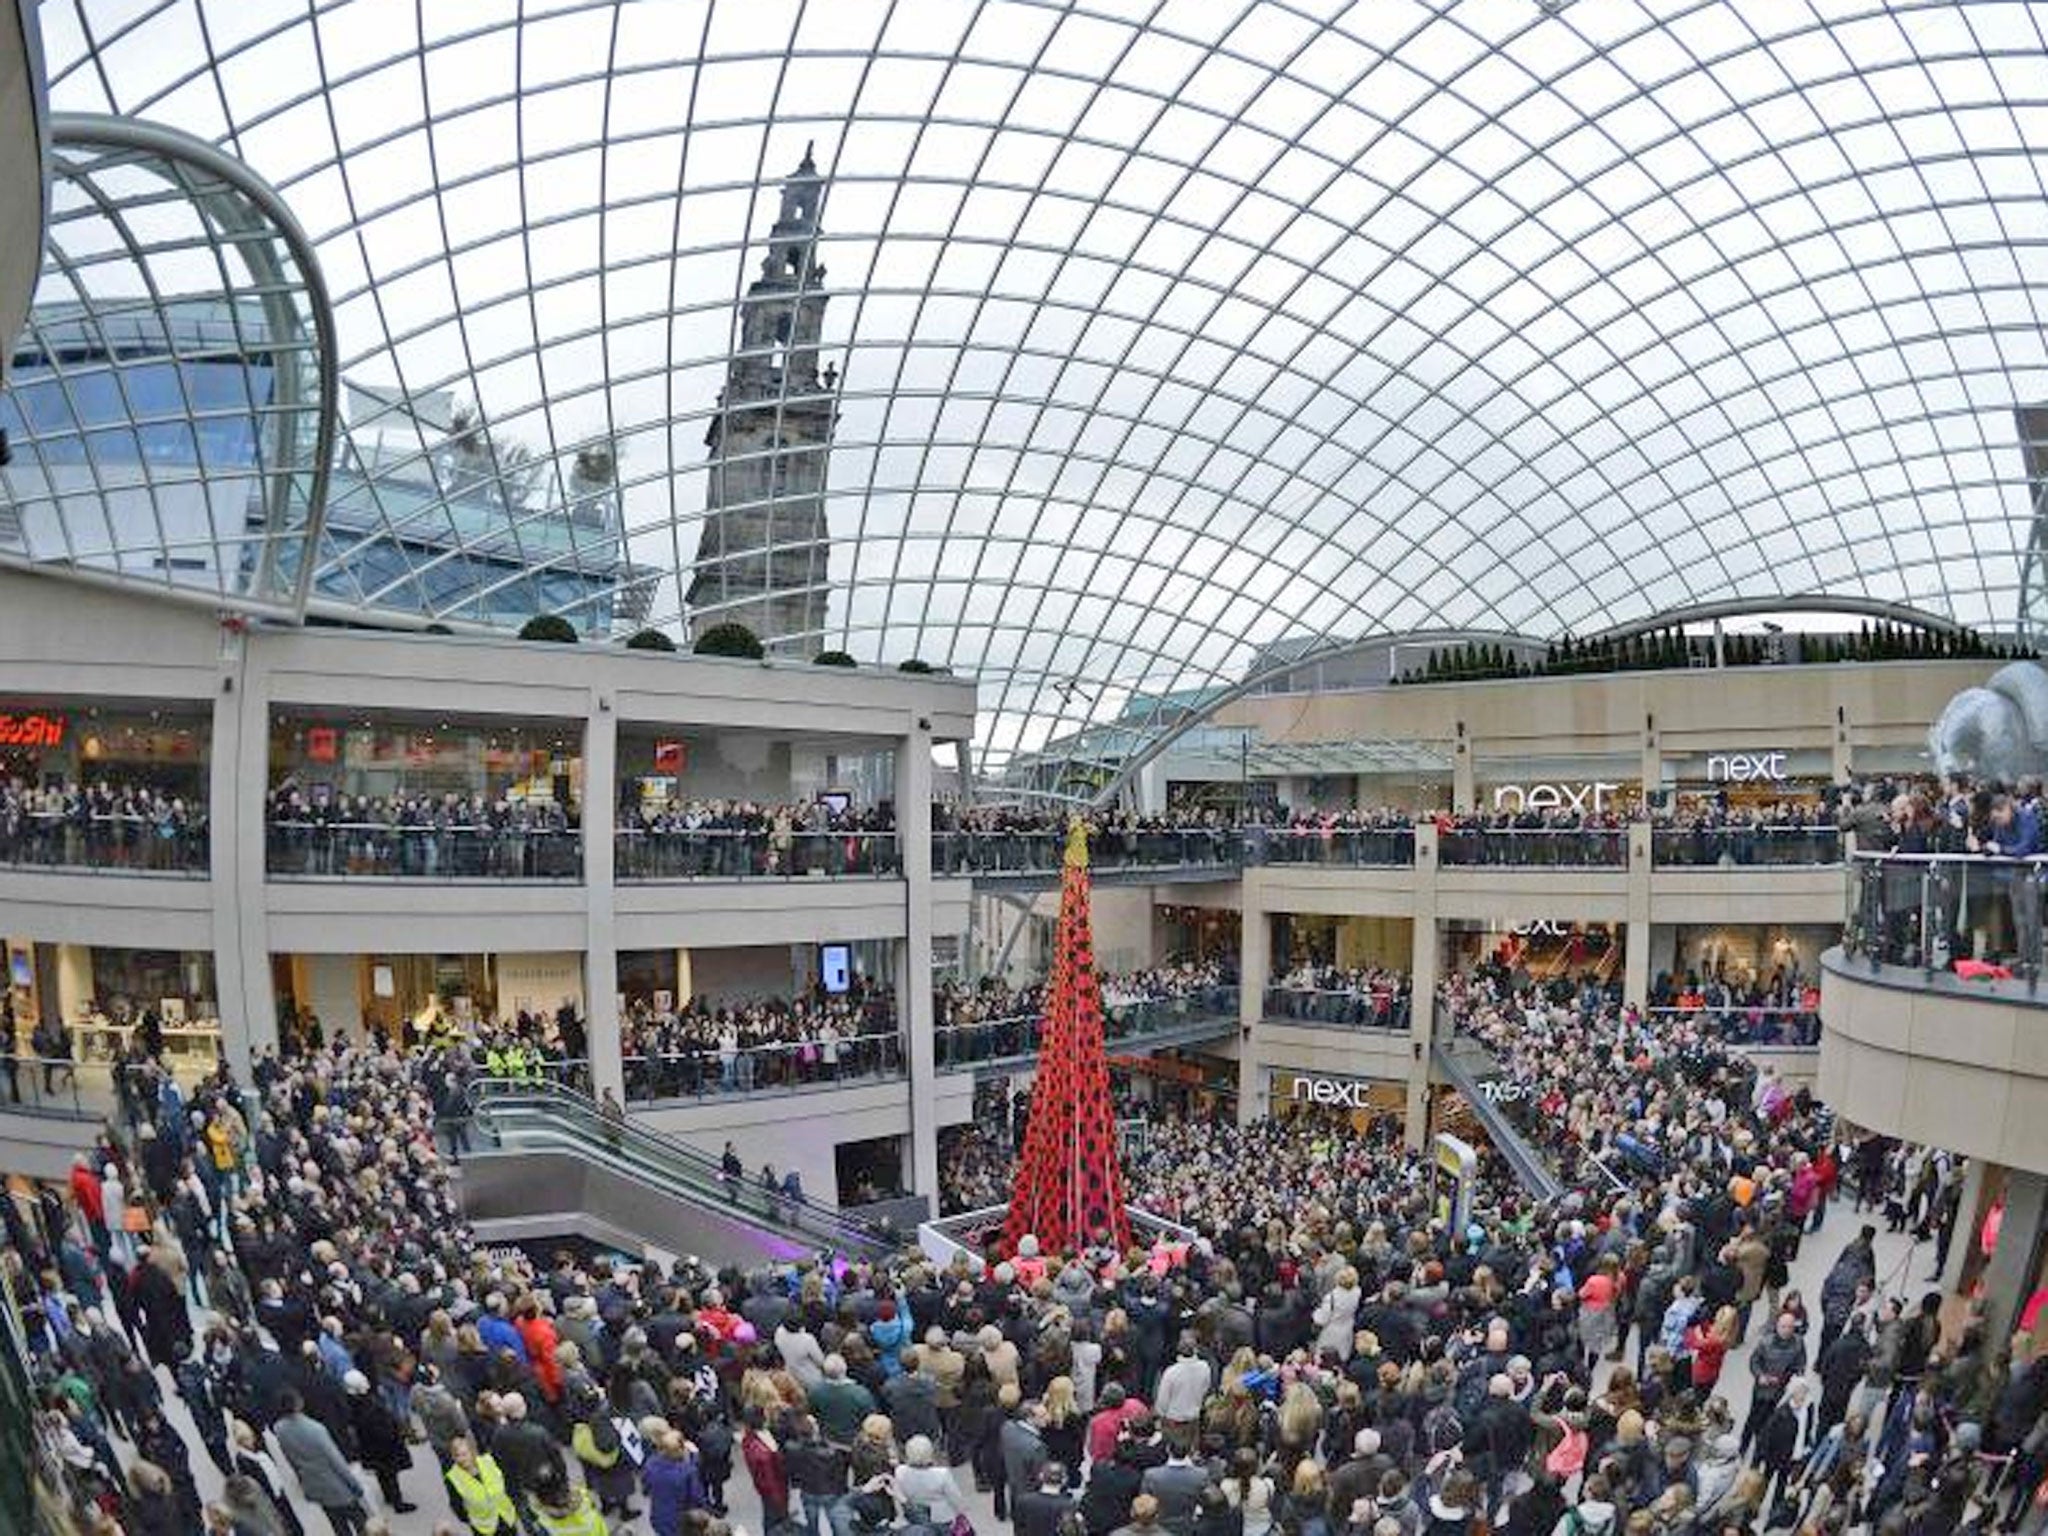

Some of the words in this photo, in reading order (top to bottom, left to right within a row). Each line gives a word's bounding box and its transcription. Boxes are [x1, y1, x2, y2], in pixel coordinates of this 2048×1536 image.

[1707, 751, 1787, 781] next
[1494, 782, 1620, 816] next
[1293, 1077, 1370, 1108] next
